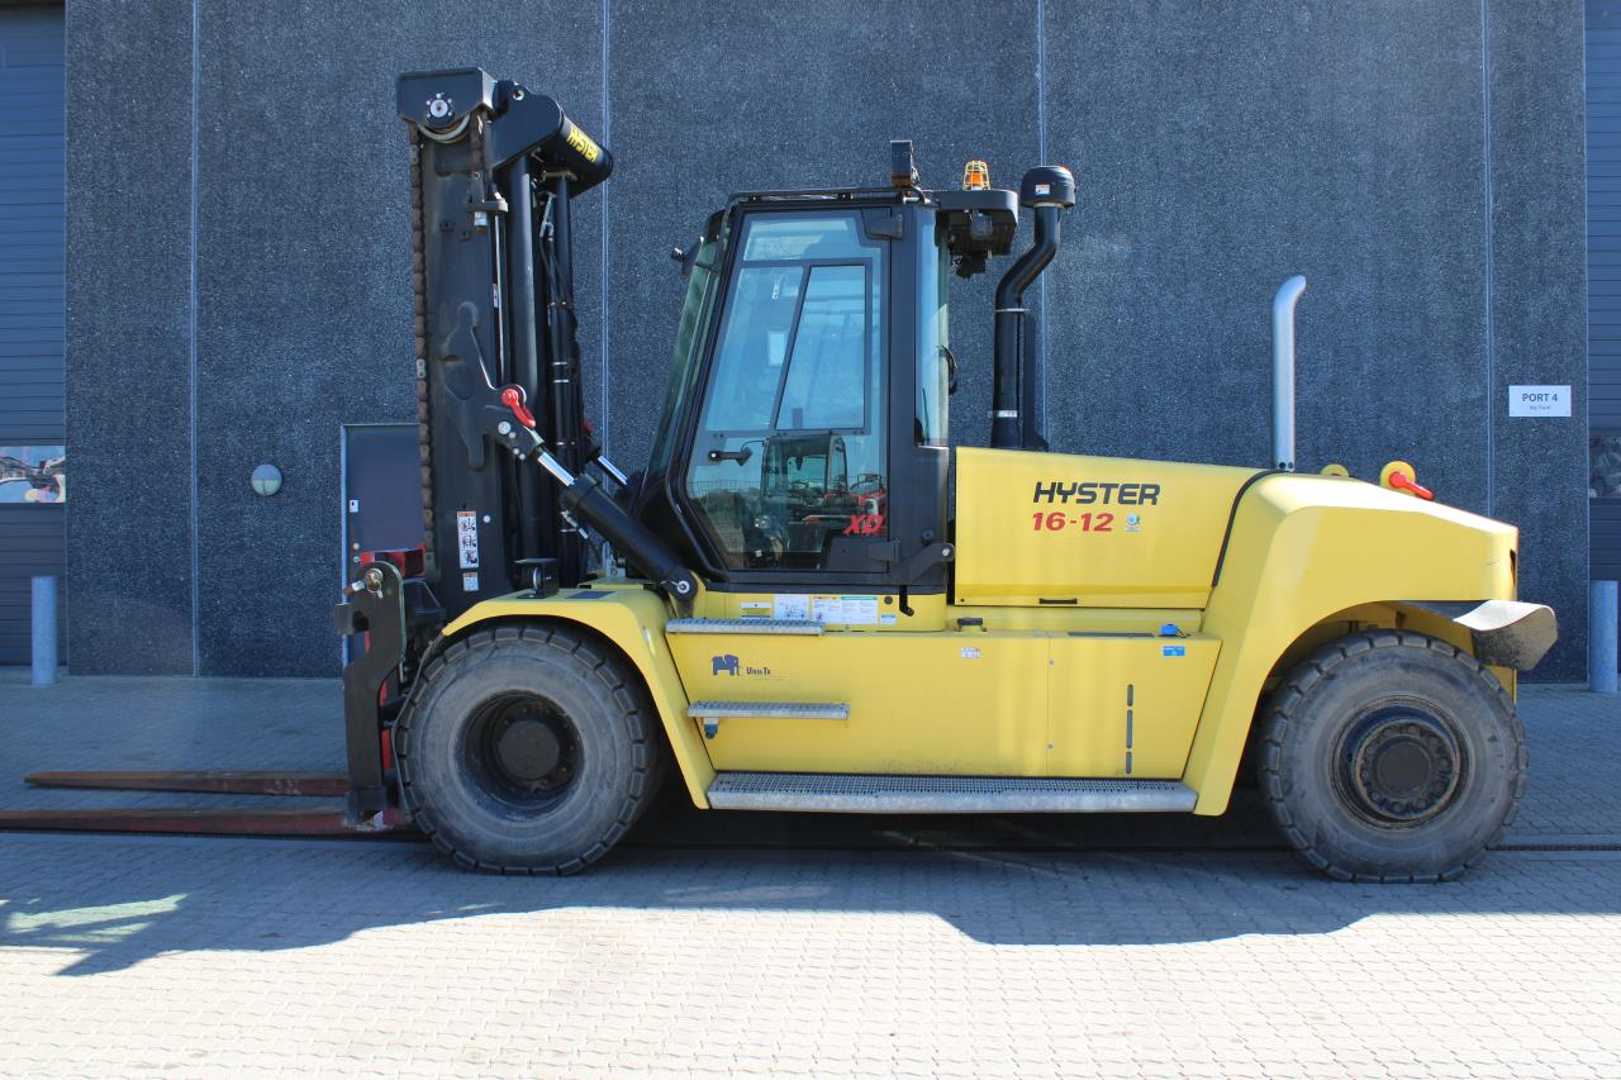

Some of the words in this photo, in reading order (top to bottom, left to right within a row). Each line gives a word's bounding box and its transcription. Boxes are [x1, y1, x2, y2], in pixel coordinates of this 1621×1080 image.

[1522, 393, 1551, 402] PORT
[1552, 393, 1558, 402] 4
[1033, 481, 1161, 505] HYSTER
[1032, 511, 1115, 532] 16-12
